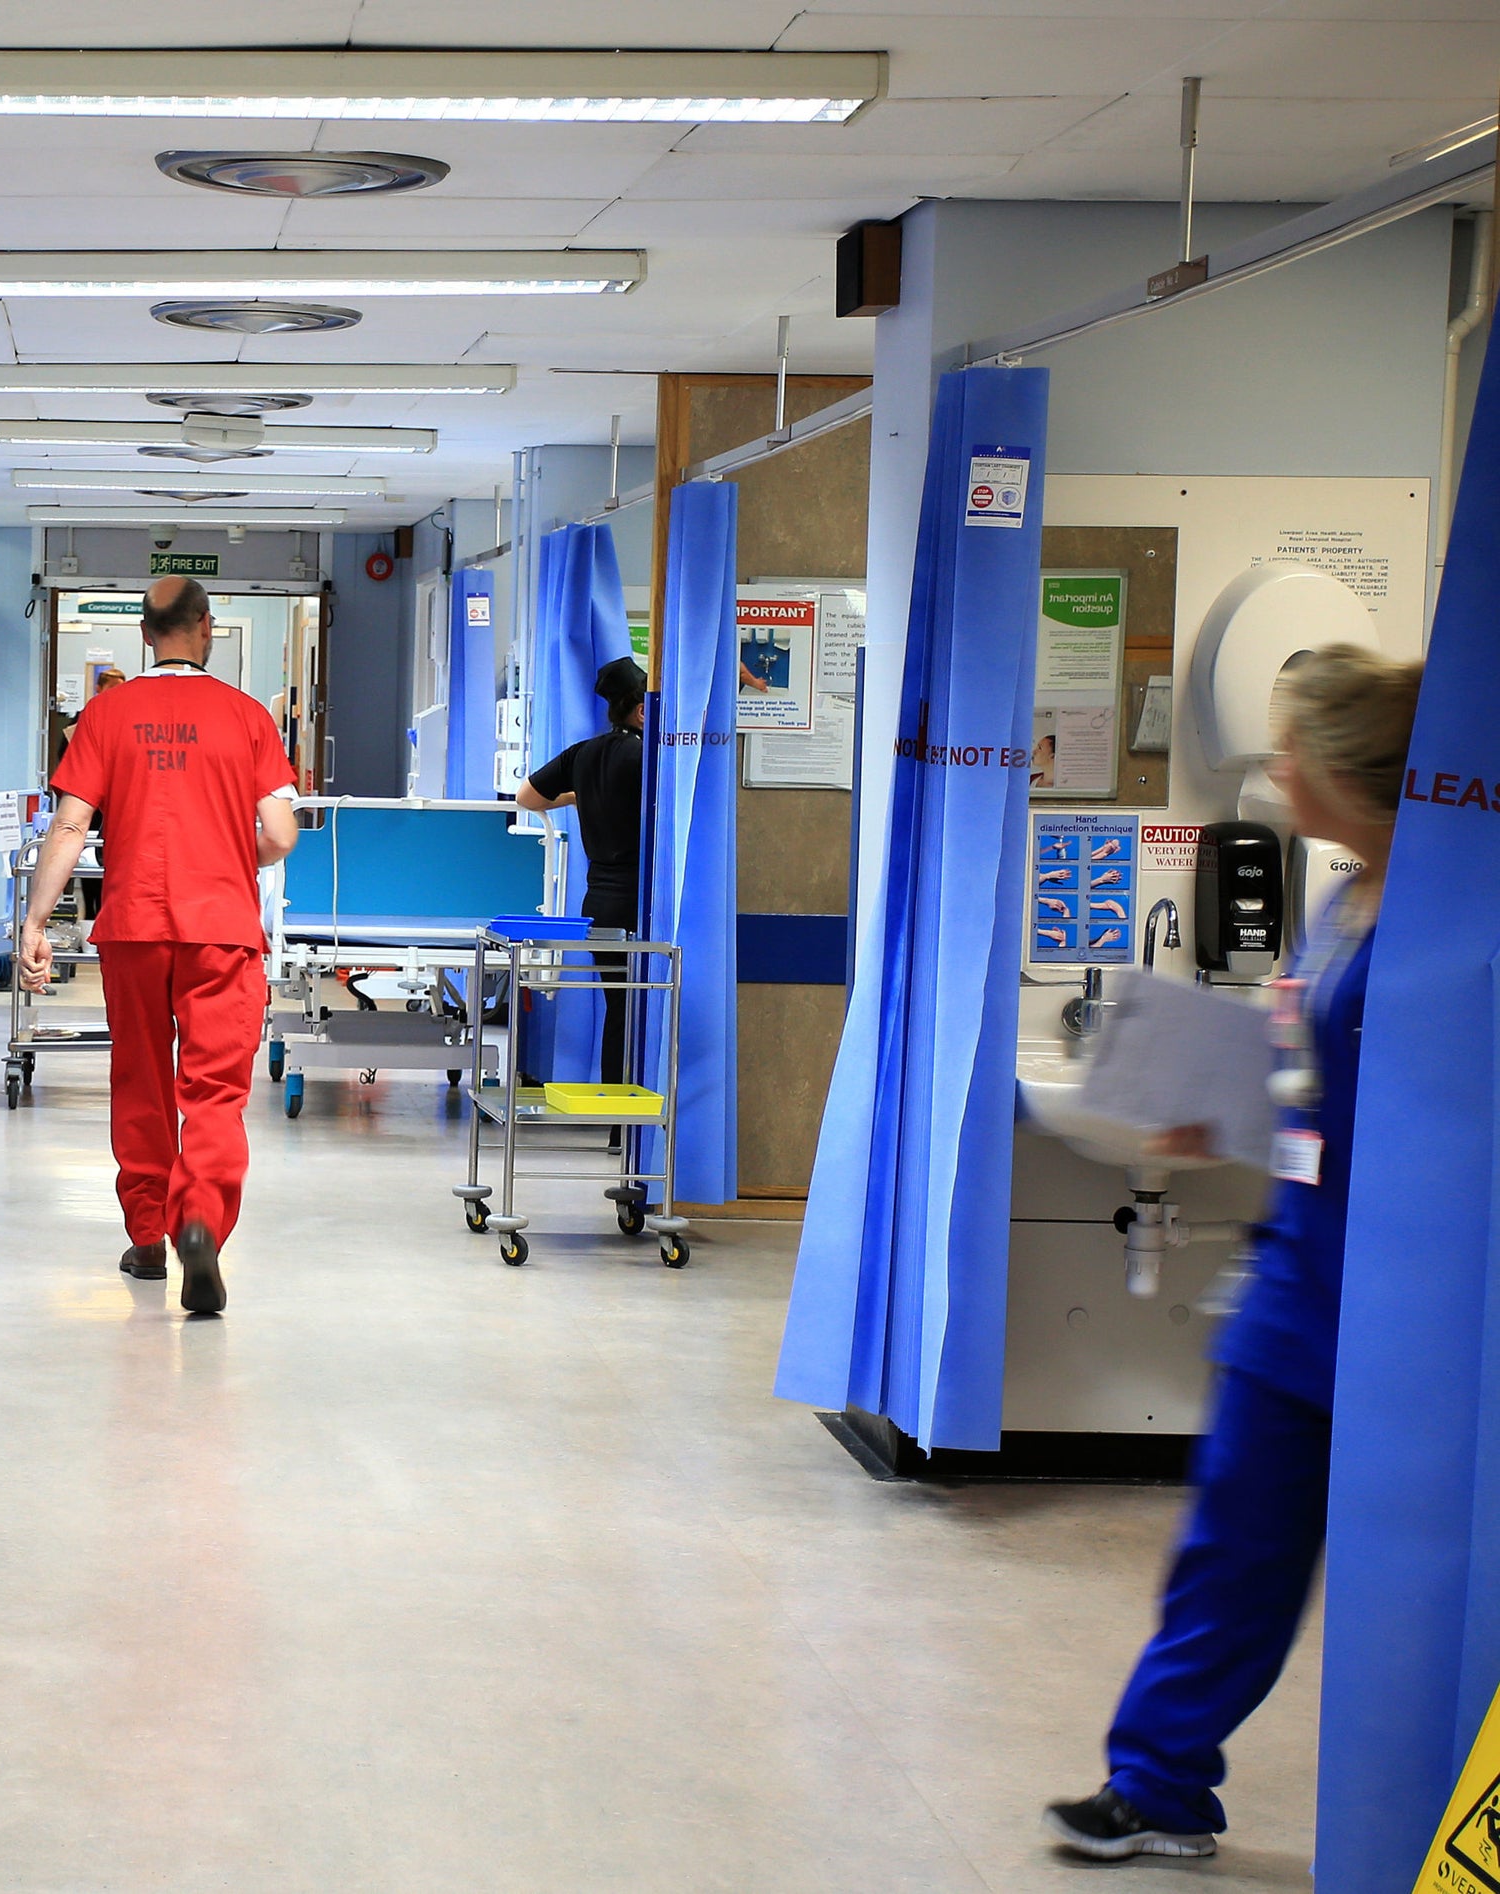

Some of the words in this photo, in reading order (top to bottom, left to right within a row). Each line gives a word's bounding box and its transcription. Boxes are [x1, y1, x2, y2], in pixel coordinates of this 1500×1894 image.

[172, 558, 193, 571] FIRE
[195, 558, 217, 572] EXIT
[132, 722, 199, 745] TRAUMA
[146, 749, 187, 772] TEAM
[950, 746, 994, 767] NOT
[1040, 823, 1089, 833] disinfection
[1091, 825, 1133, 833] technique
[1148, 847, 1176, 855] VERY
[1179, 847, 1198, 855] HO
[1156, 858, 1193, 866] WATER
[1240, 928, 1267, 937] HAND
